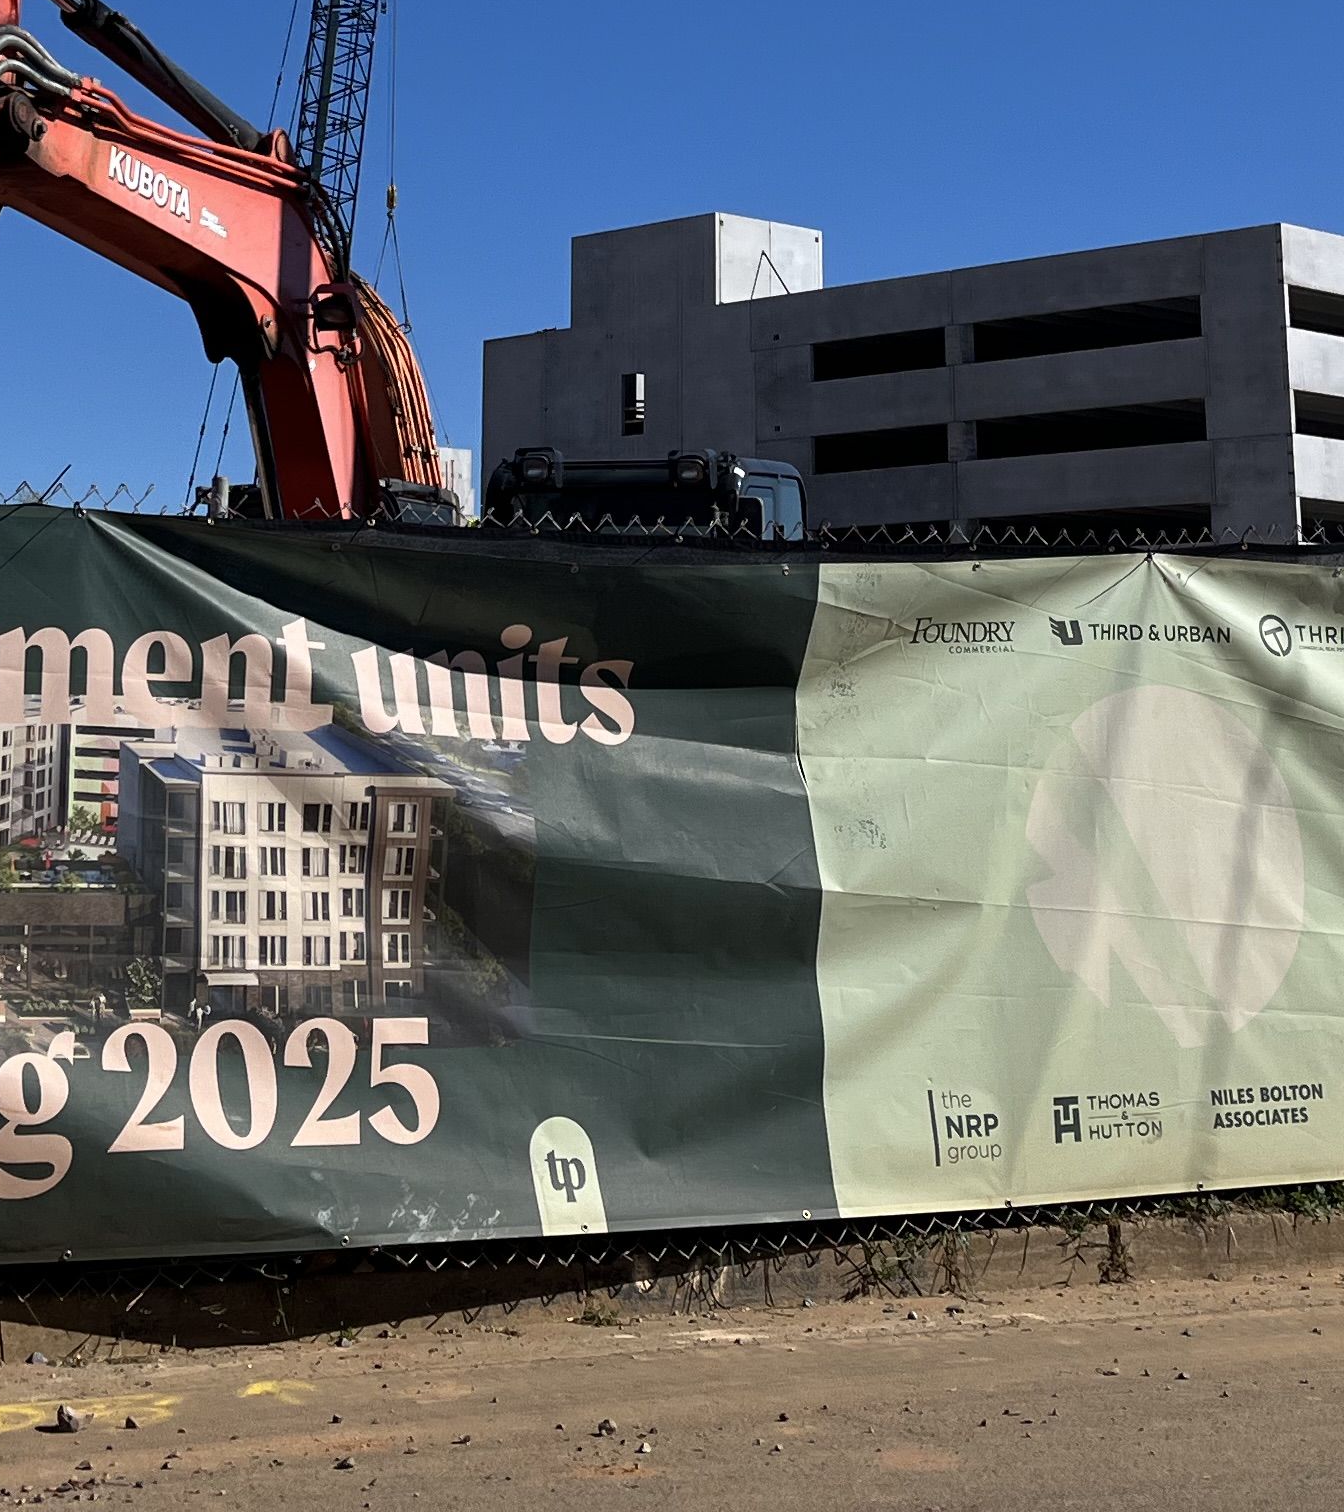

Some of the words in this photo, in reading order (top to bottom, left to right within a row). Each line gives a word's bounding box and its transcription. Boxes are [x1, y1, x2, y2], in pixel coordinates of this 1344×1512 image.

[108, 146, 191, 223] KUBOTA
[1088, 623, 1143, 641] THIRD
[1148, 624, 1160, 642] &
[1164, 625, 1231, 644] URBAN
[948, 645, 1015, 654] COMMERCIAL
[351, 624, 635, 745] units
[101, 1016, 441, 1154] 2025
[1210, 1088, 1255, 1106] NILES
[1259, 1083, 1324, 1103] BOLTON
[941, 1090, 973, 1110] the
[1086, 1091, 1161, 1110] THOMAS
[945, 1113, 999, 1139] NRP
[1121, 1110, 1129, 1121] &
[1213, 1107, 1309, 1129] ASSOCIATES
[1088, 1120, 1163, 1140] HUTTON
[947, 1143, 1003, 1165] group
[545, 1149, 586, 1202] tp
